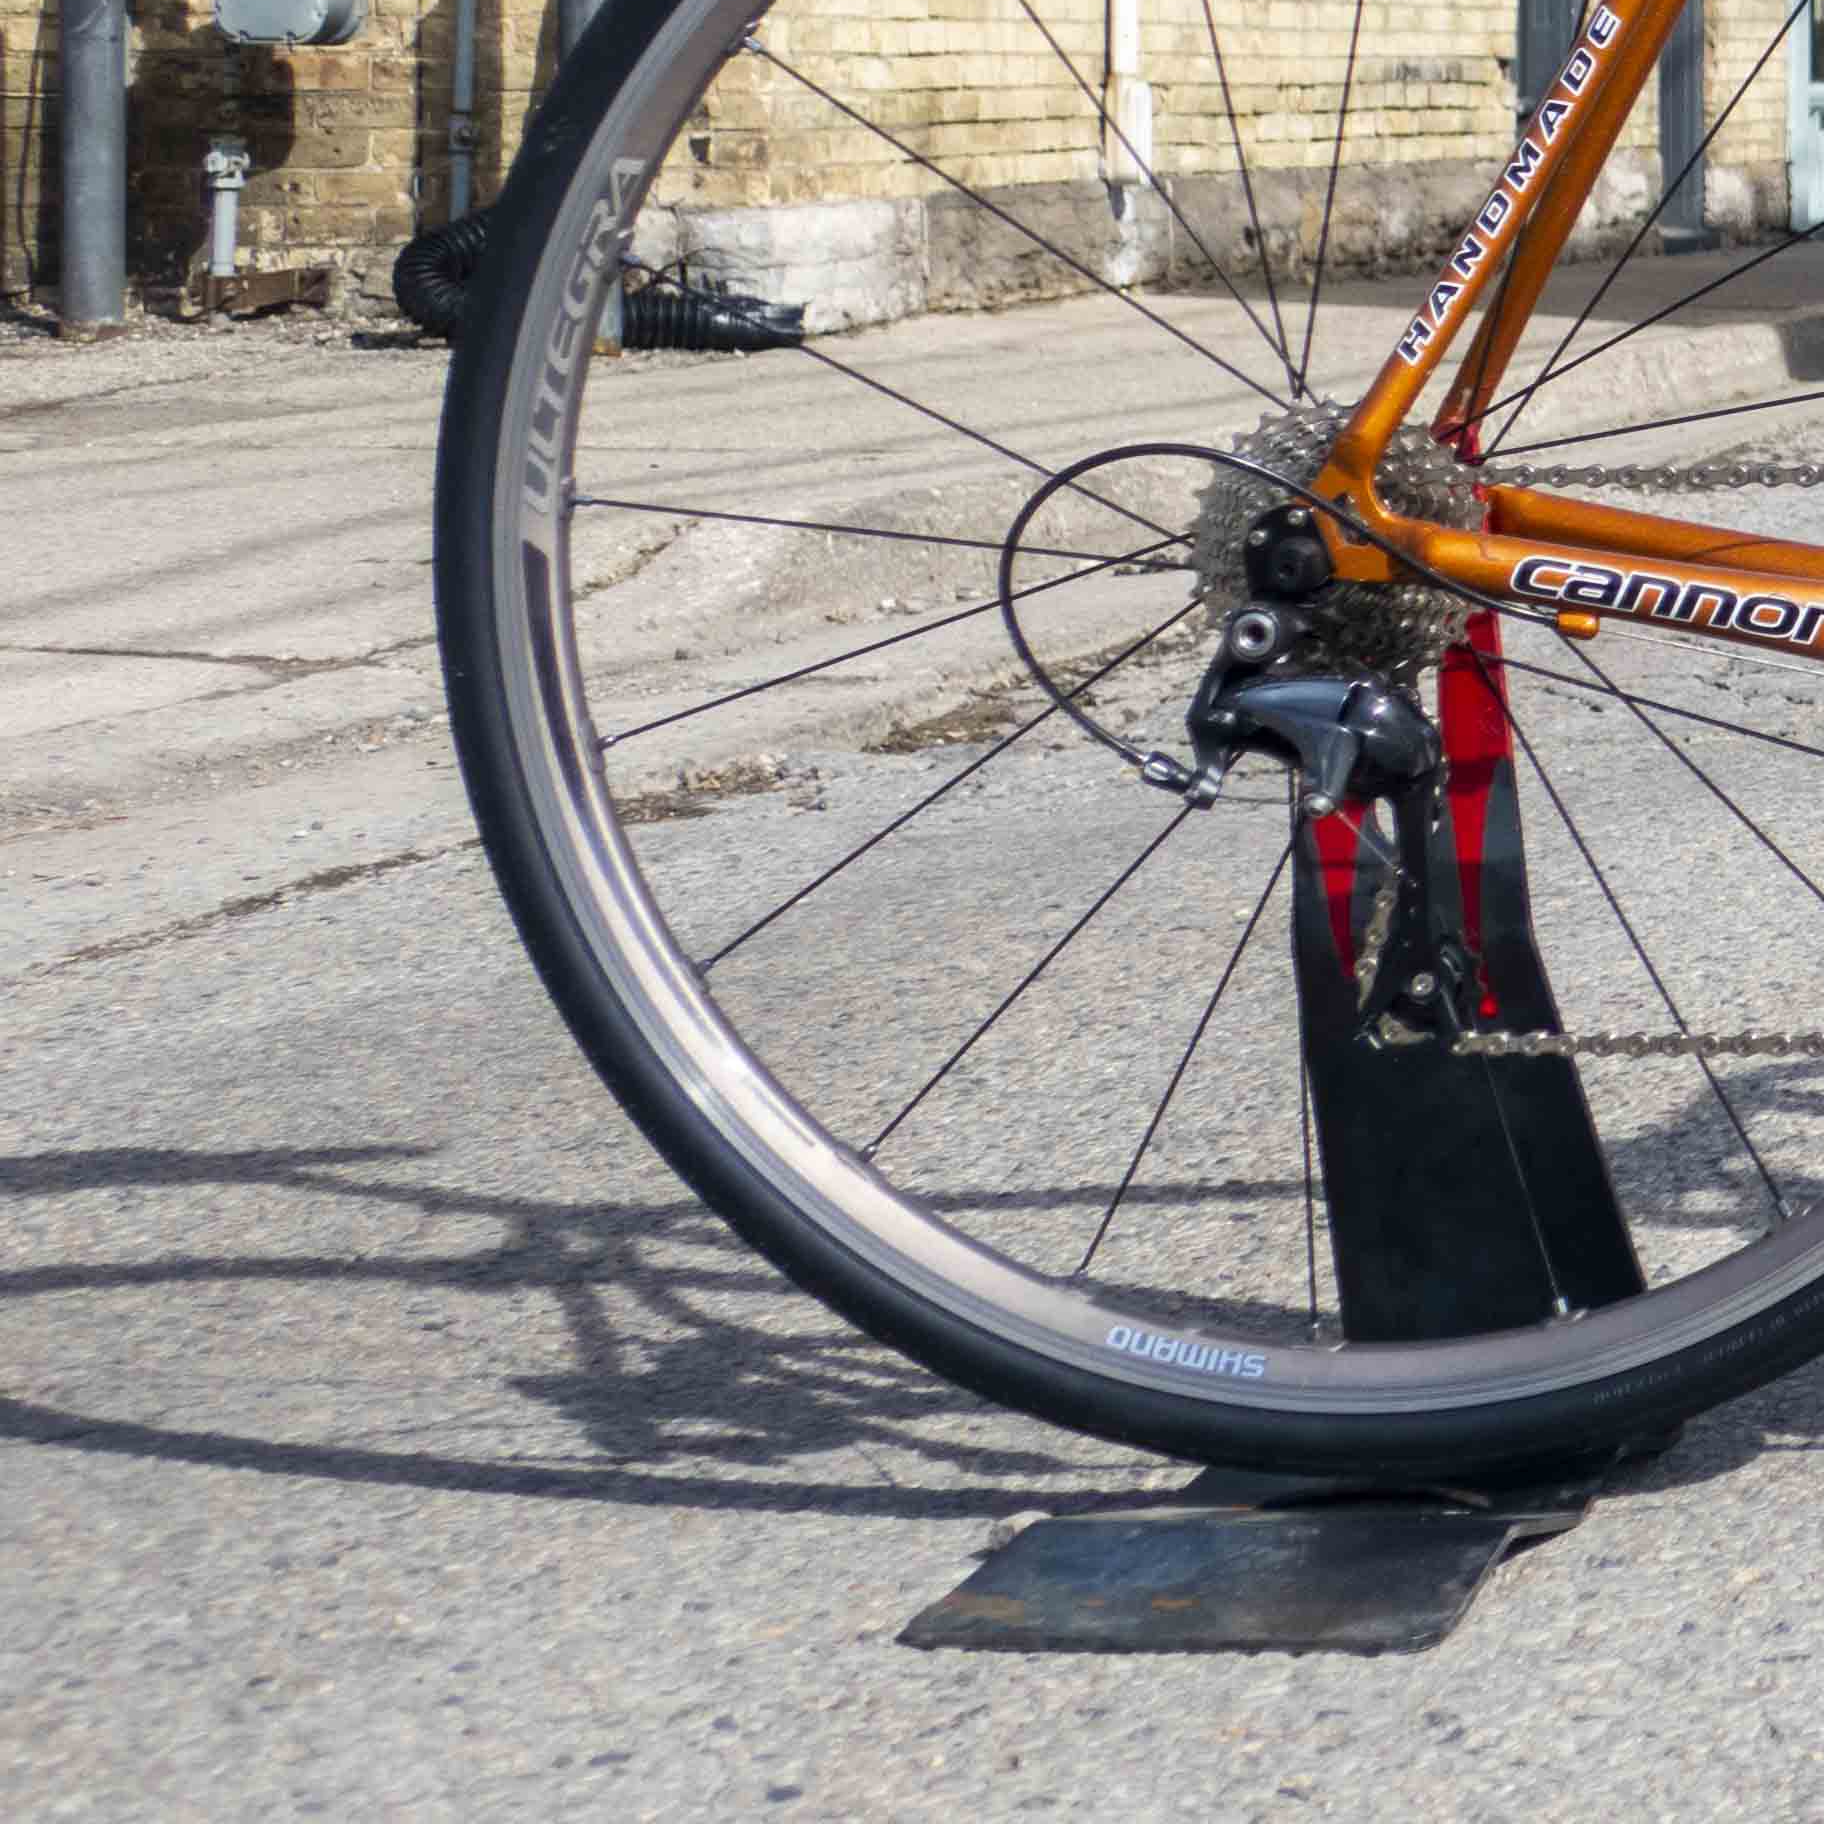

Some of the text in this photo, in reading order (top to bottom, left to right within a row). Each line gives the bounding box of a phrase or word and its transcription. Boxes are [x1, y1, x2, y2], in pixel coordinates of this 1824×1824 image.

[522, 158, 650, 515] ULTEGRA
[1396, 6, 1622, 367] HANDMADE
[1105, 1325, 1266, 1378] SHIMANO
